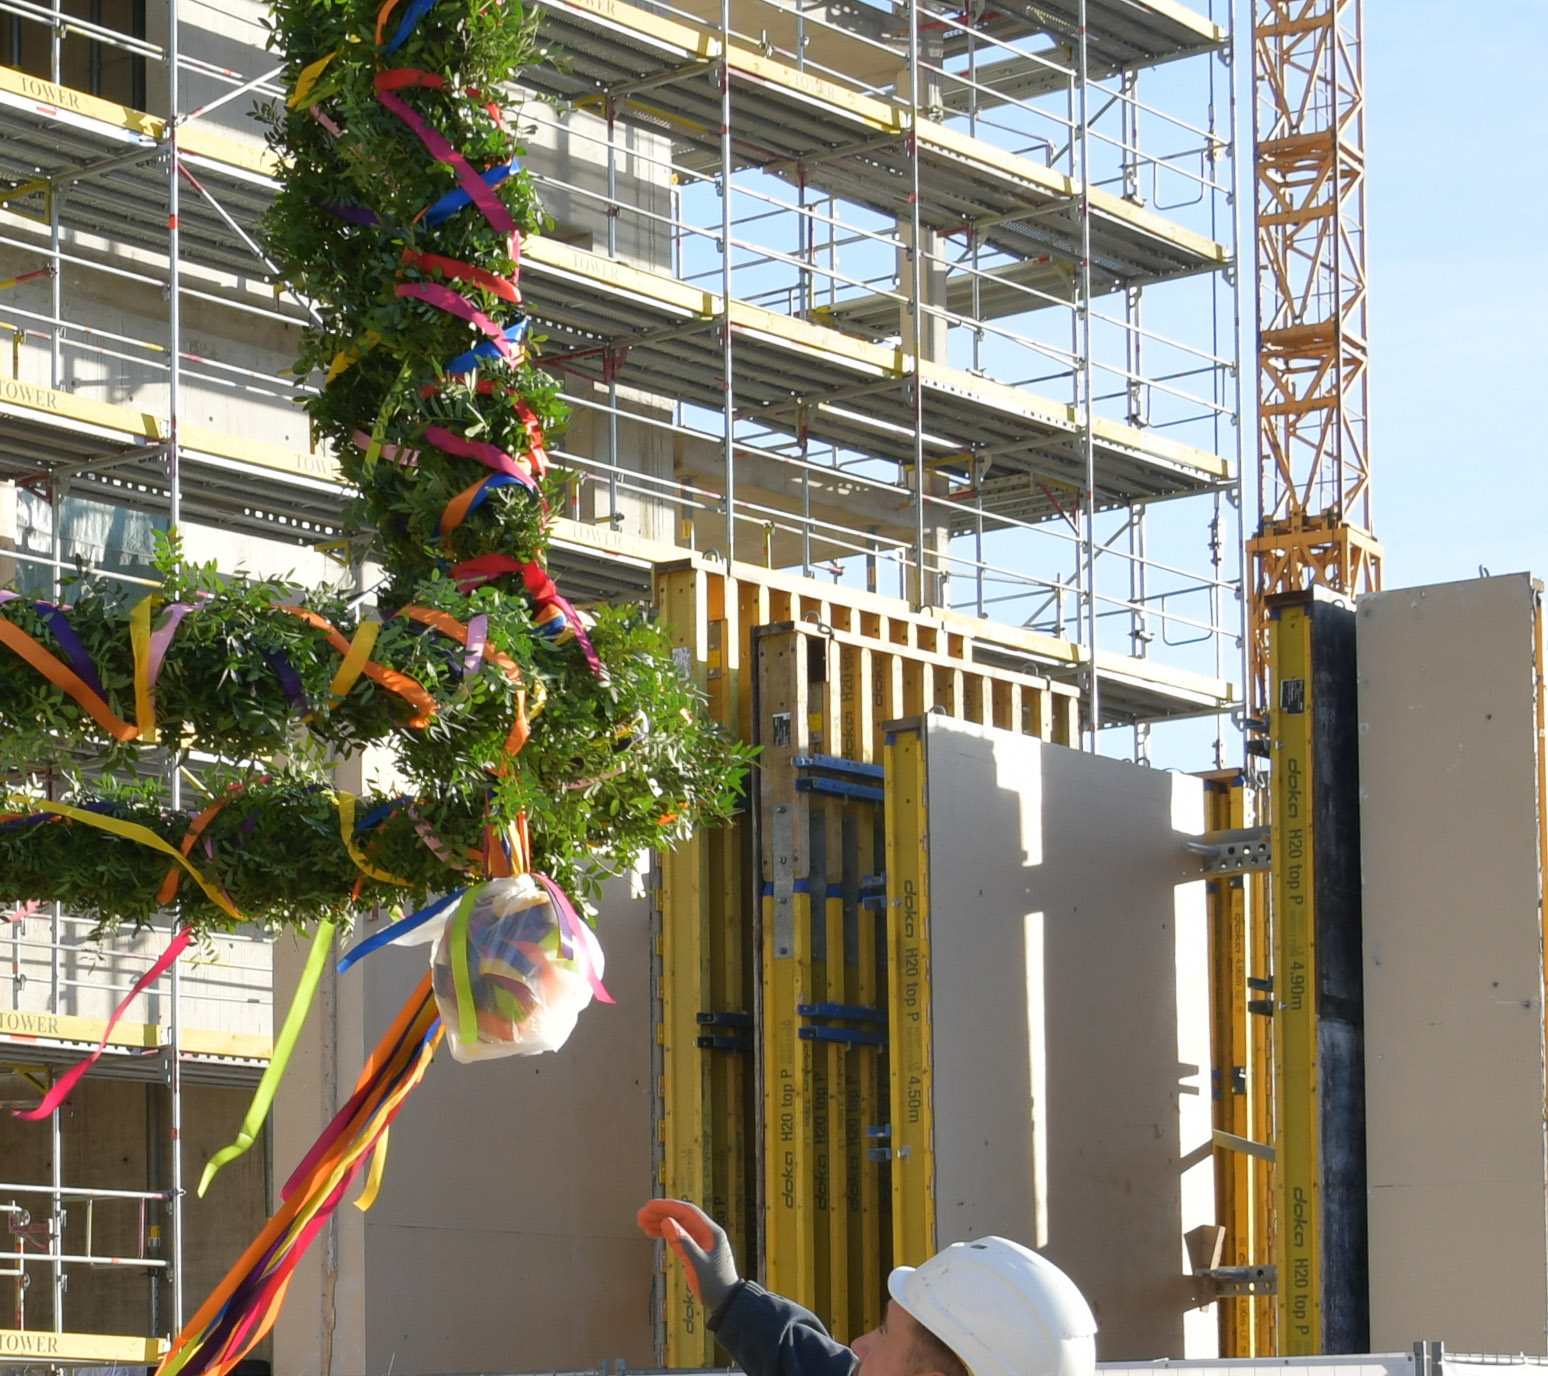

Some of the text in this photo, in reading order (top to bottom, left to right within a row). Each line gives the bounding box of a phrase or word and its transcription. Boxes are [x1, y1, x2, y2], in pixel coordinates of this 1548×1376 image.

[18, 77, 80, 111] TOWER
[841, 673, 853, 702] H20
[1288, 758, 1297, 819] doka
[1289, 829, 1303, 859] H20
[1288, 863, 1301, 891] top
[904, 879, 914, 939] doka
[1291, 895, 1304, 906] P
[906, 947, 919, 977] H20
[905, 980, 919, 1008] top
[1290, 961, 1304, 1011] 4.90m
[909, 1009, 920, 1023] P
[780, 1068, 792, 1080] P
[781, 1084, 795, 1111] top
[907, 1074, 922, 1124] 4.50m
[781, 1114, 794, 1142] H20
[813, 1071, 829, 1212] doka H20 top P
[846, 1090, 860, 1213] doka H20 top
[785, 1151, 794, 1210] doka
[1294, 1187, 1309, 1336] doka H20 top P
[684, 1290, 695, 1335] dok
